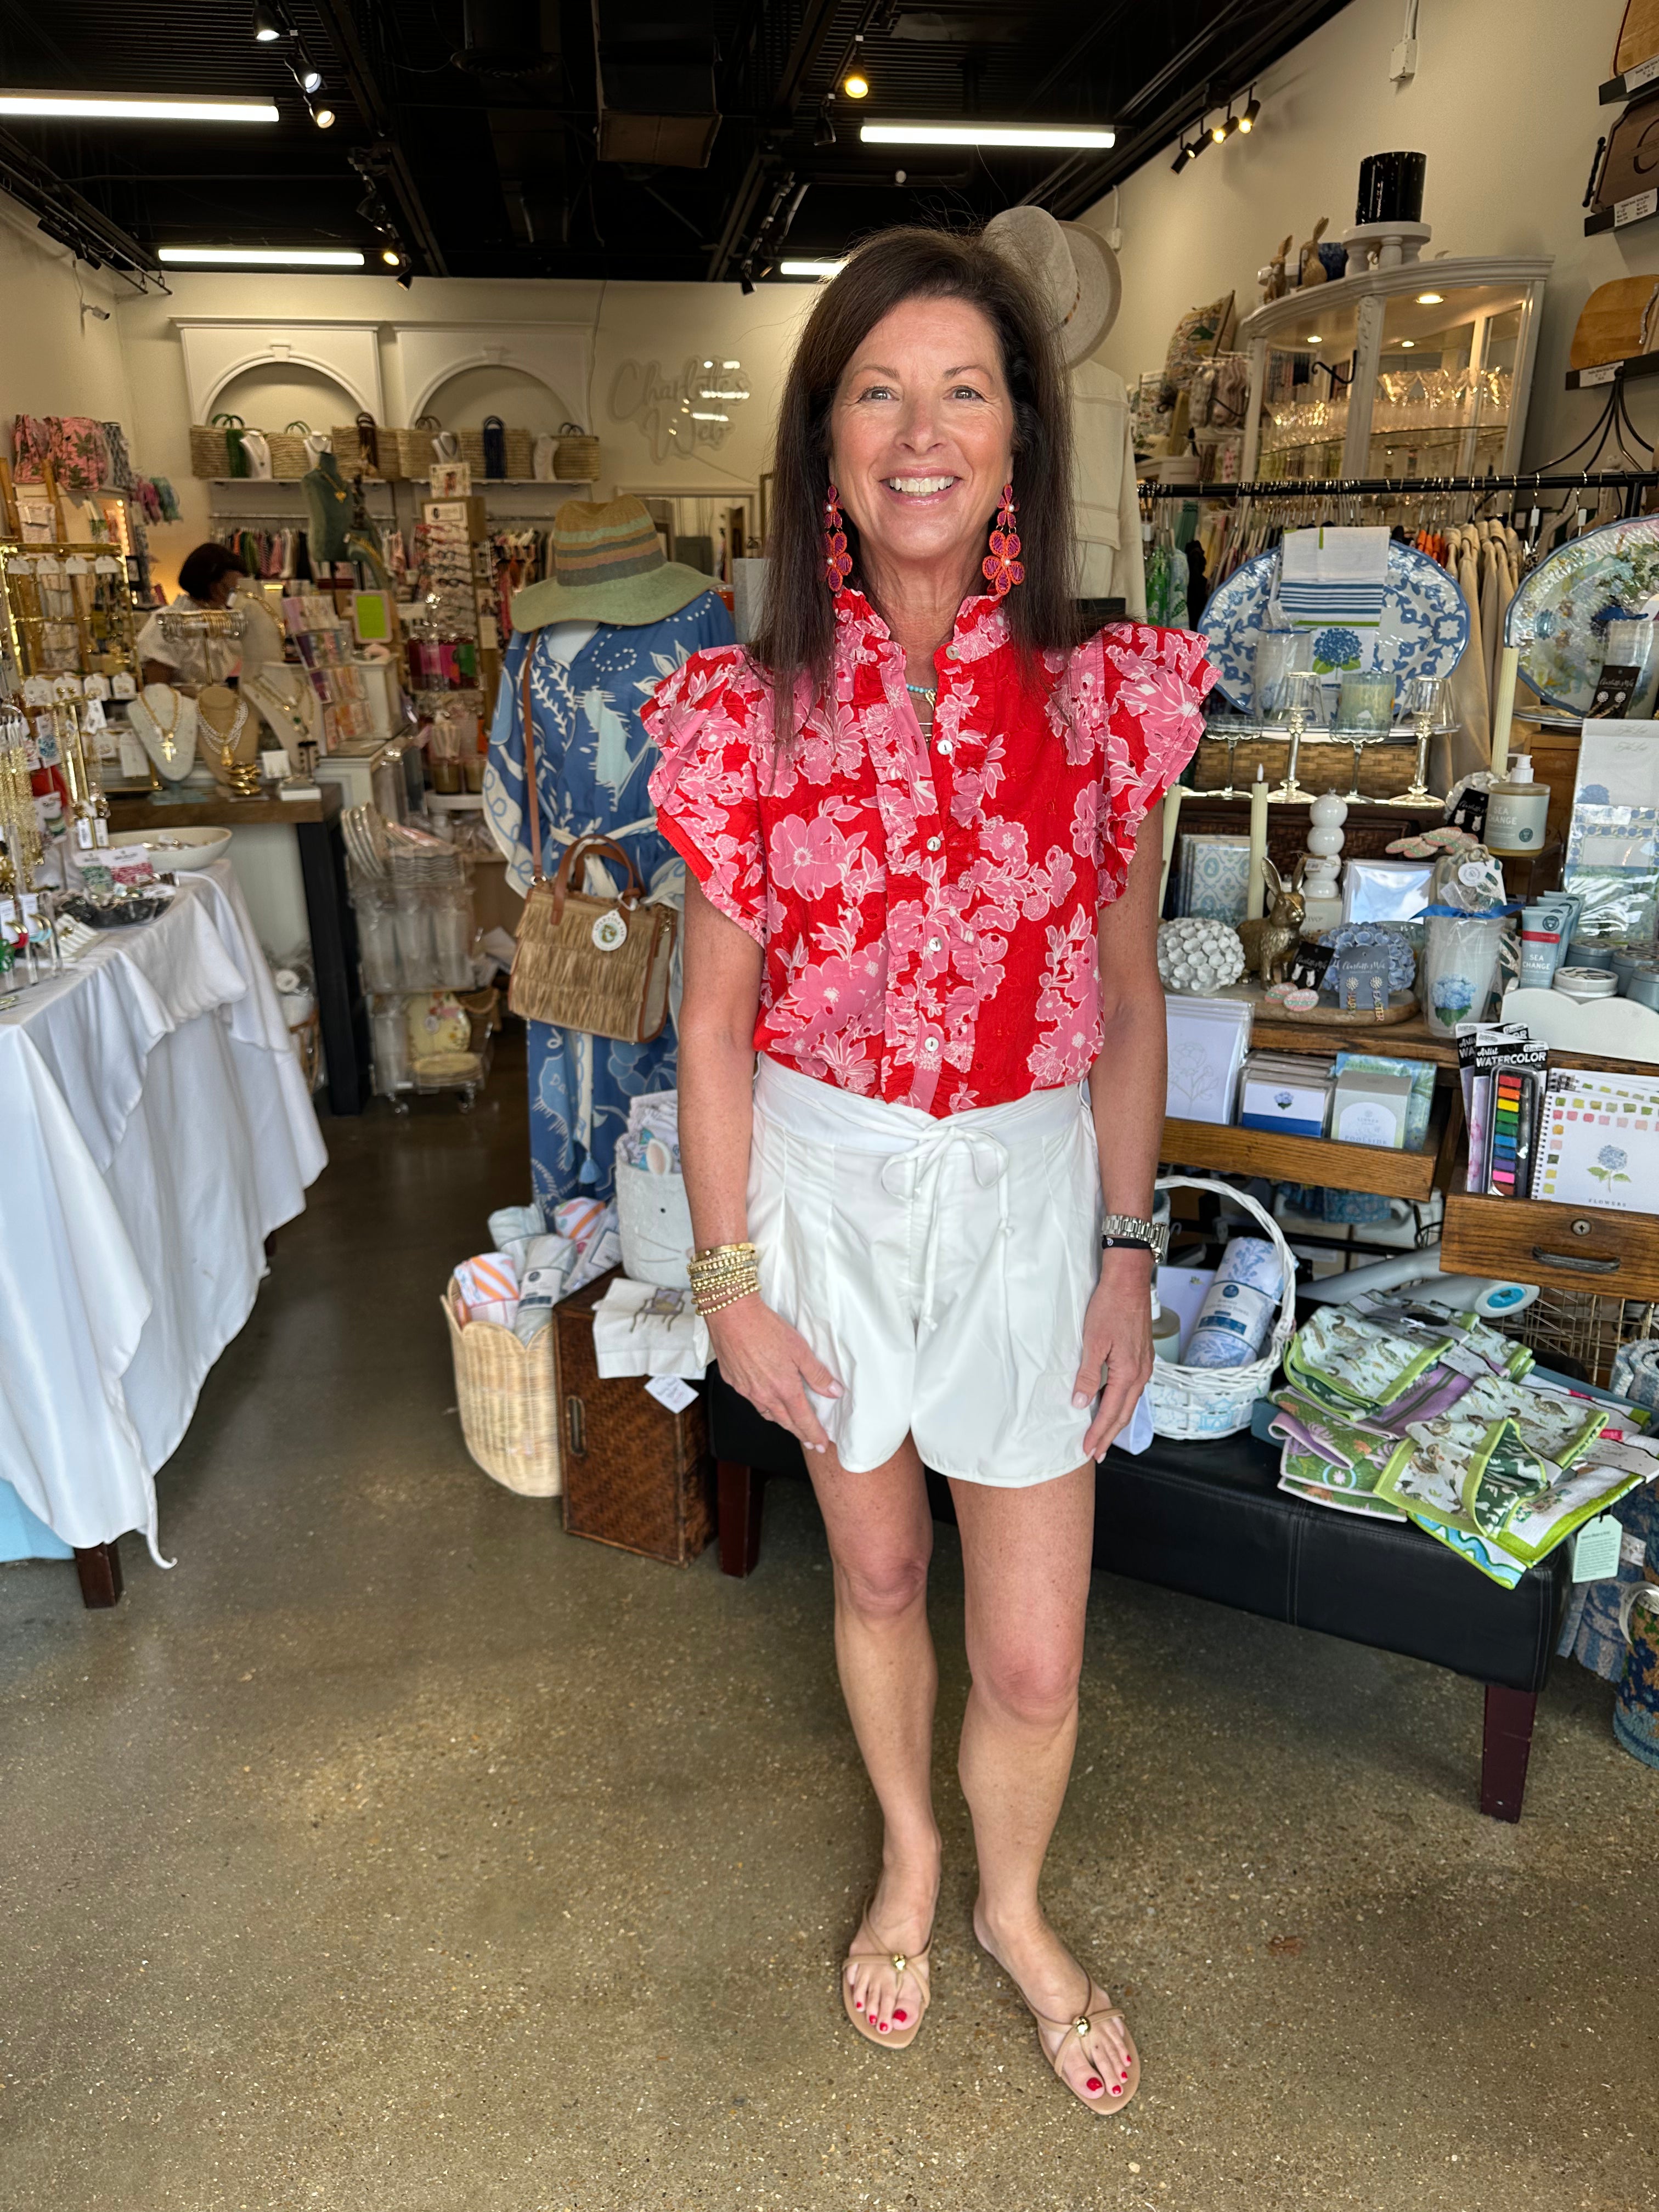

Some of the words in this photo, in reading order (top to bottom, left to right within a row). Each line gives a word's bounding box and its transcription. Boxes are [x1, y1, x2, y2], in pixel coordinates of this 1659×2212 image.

[1494, 806, 1508, 815] SEA
[1487, 815, 1517, 825] CHANGE
[1522, 962, 1550, 970] CHANGE
[1477, 1047, 1499, 1057] Artist
[1476, 1052, 1547, 1068] WATERCOLOR
[1588, 1198, 1627, 1207] FLOWERS
